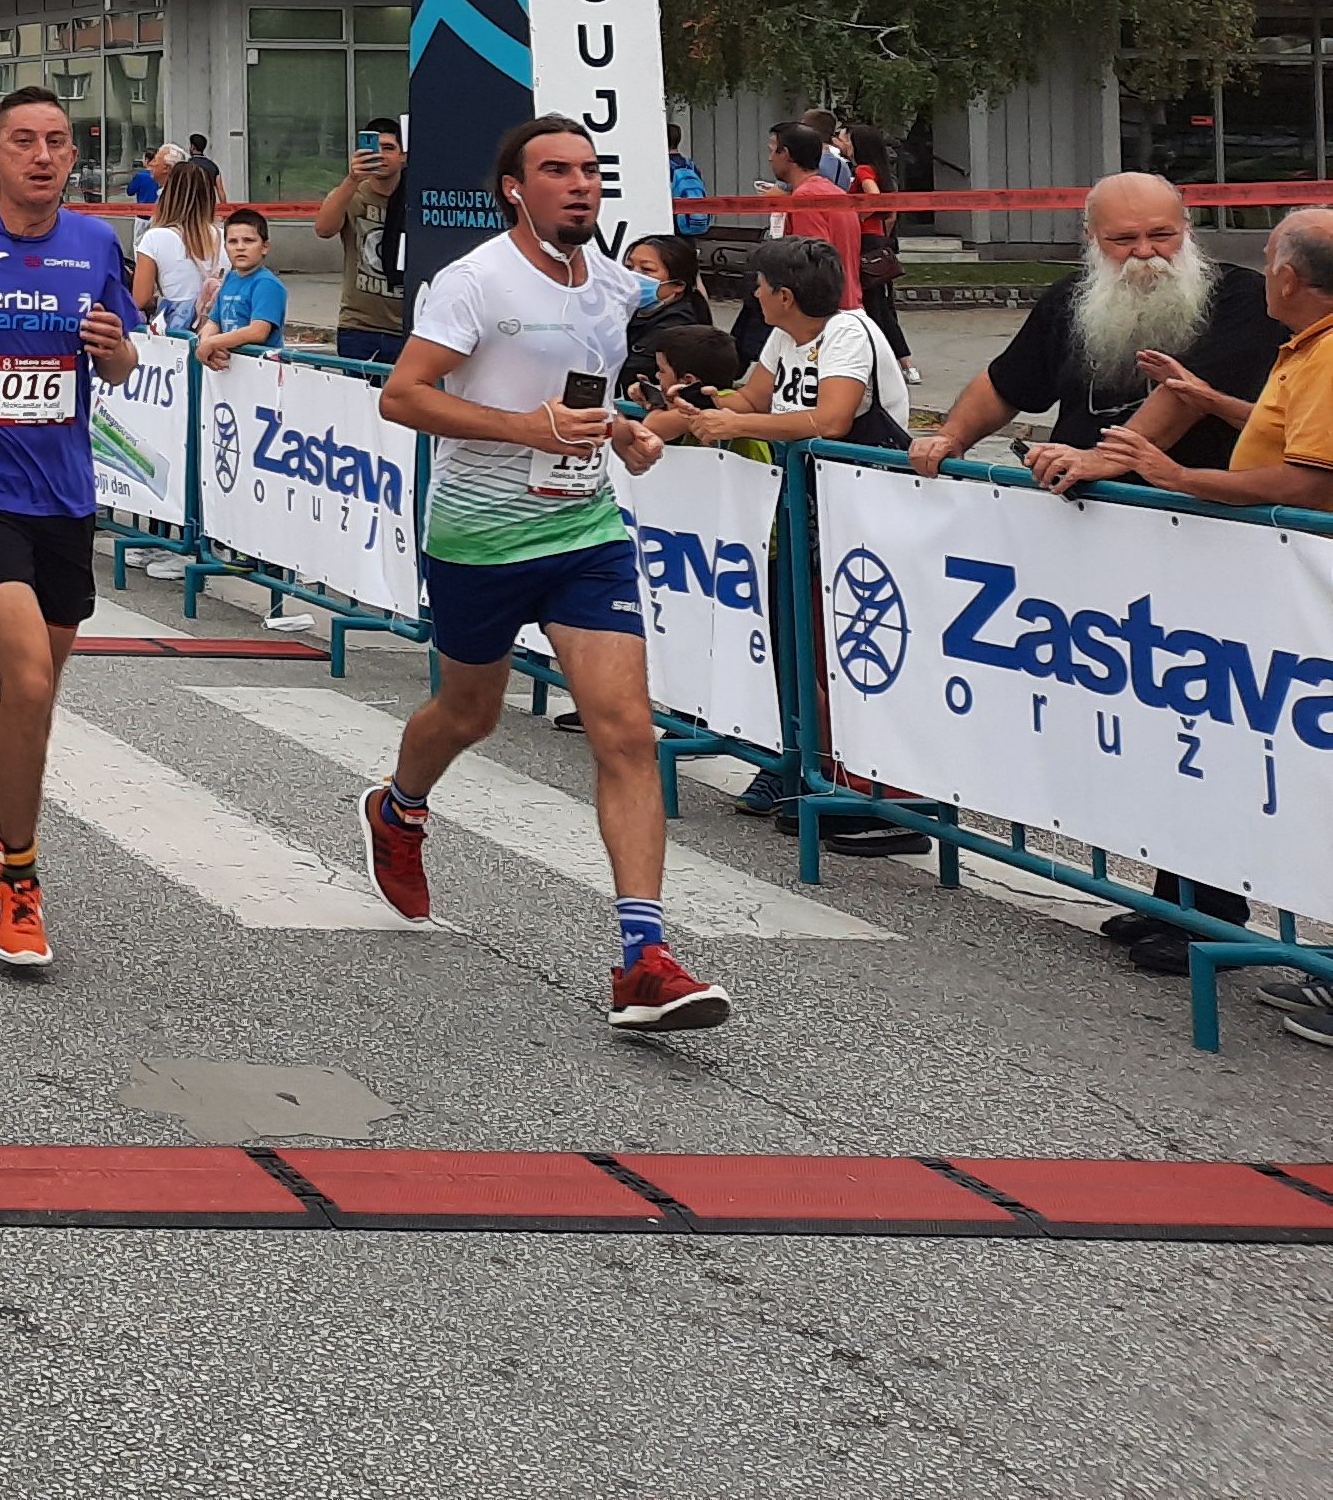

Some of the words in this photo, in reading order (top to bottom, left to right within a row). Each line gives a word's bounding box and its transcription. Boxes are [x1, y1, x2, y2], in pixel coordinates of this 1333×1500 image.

[1, 373, 62, 401] 016
[252, 405, 403, 516] Zastava
[111, 478, 131, 498] dan
